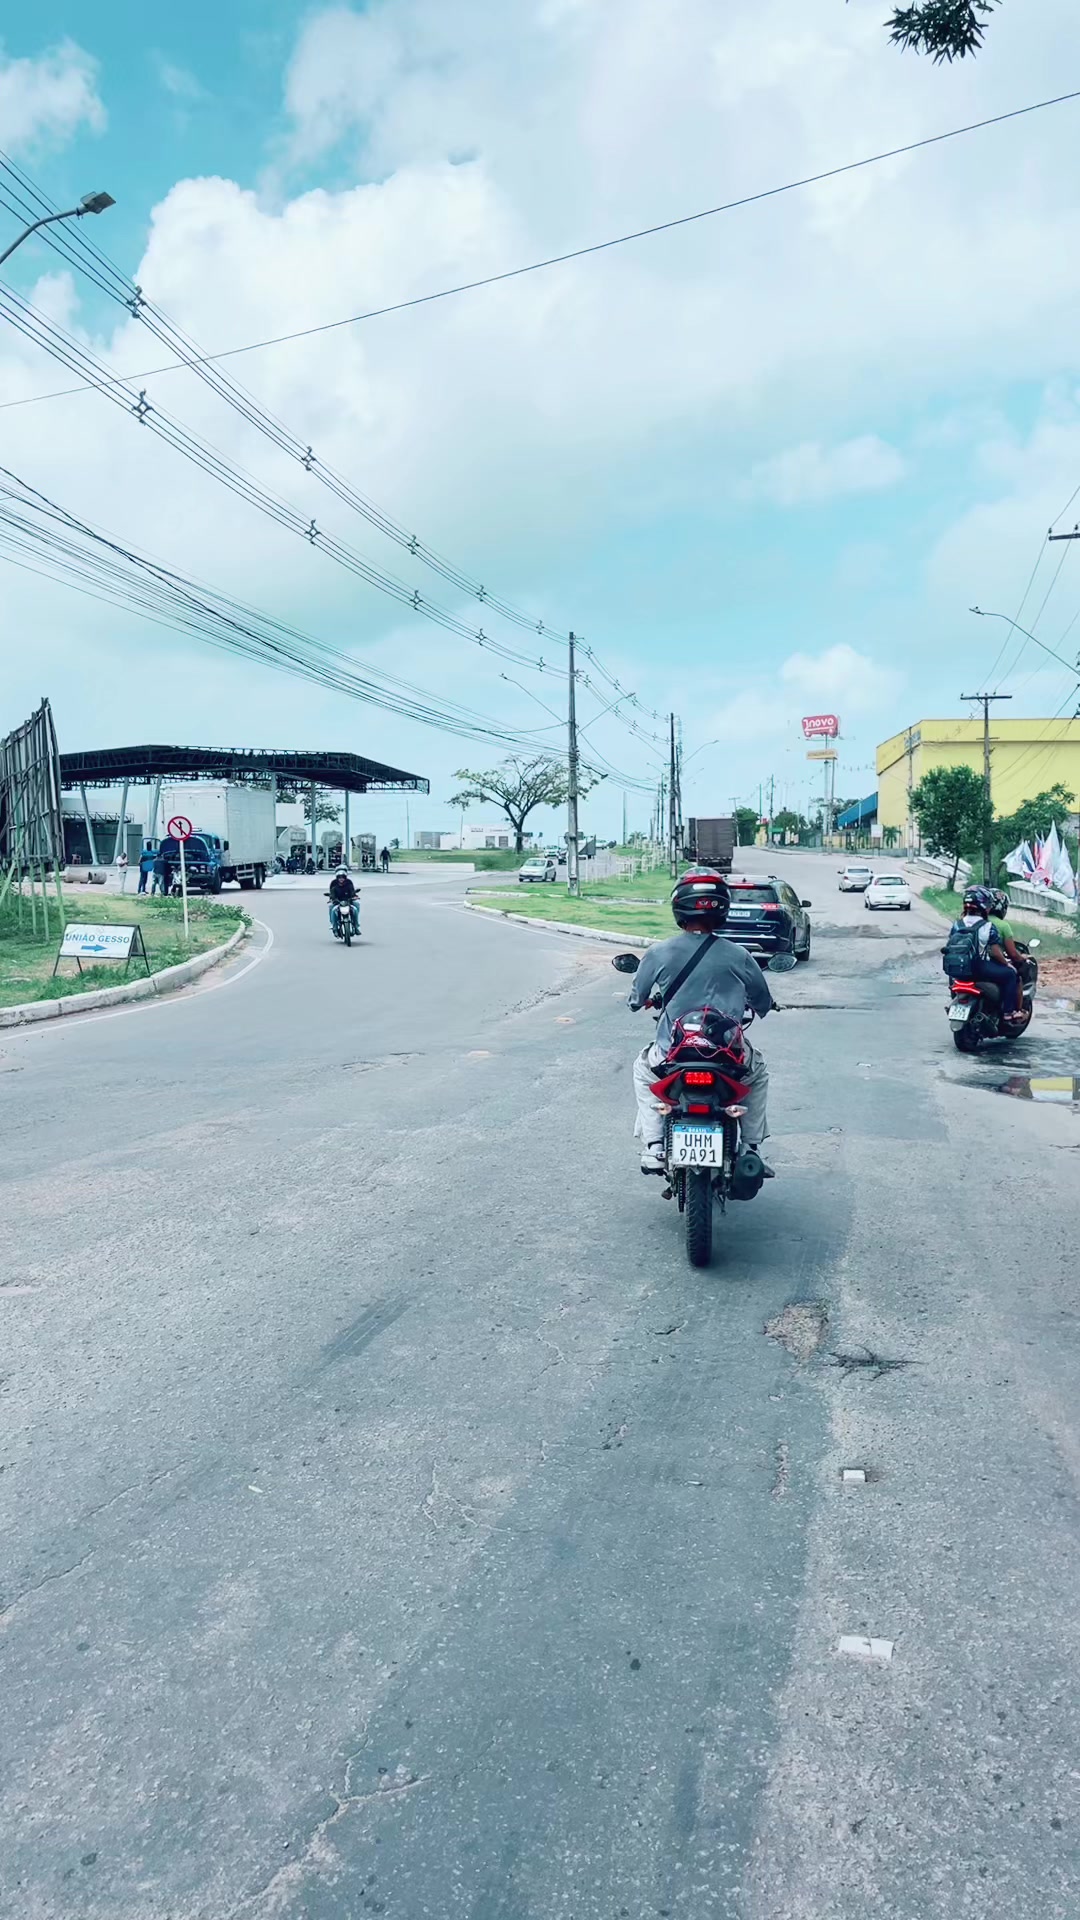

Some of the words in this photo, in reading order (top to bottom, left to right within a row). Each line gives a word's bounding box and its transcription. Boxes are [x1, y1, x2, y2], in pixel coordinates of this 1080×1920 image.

[65, 933, 96, 942] UNIÃO
[98, 934, 130, 944] GESSO
[684, 1134, 712, 1148] UHM
[680, 1148, 716, 1163] 9A91
